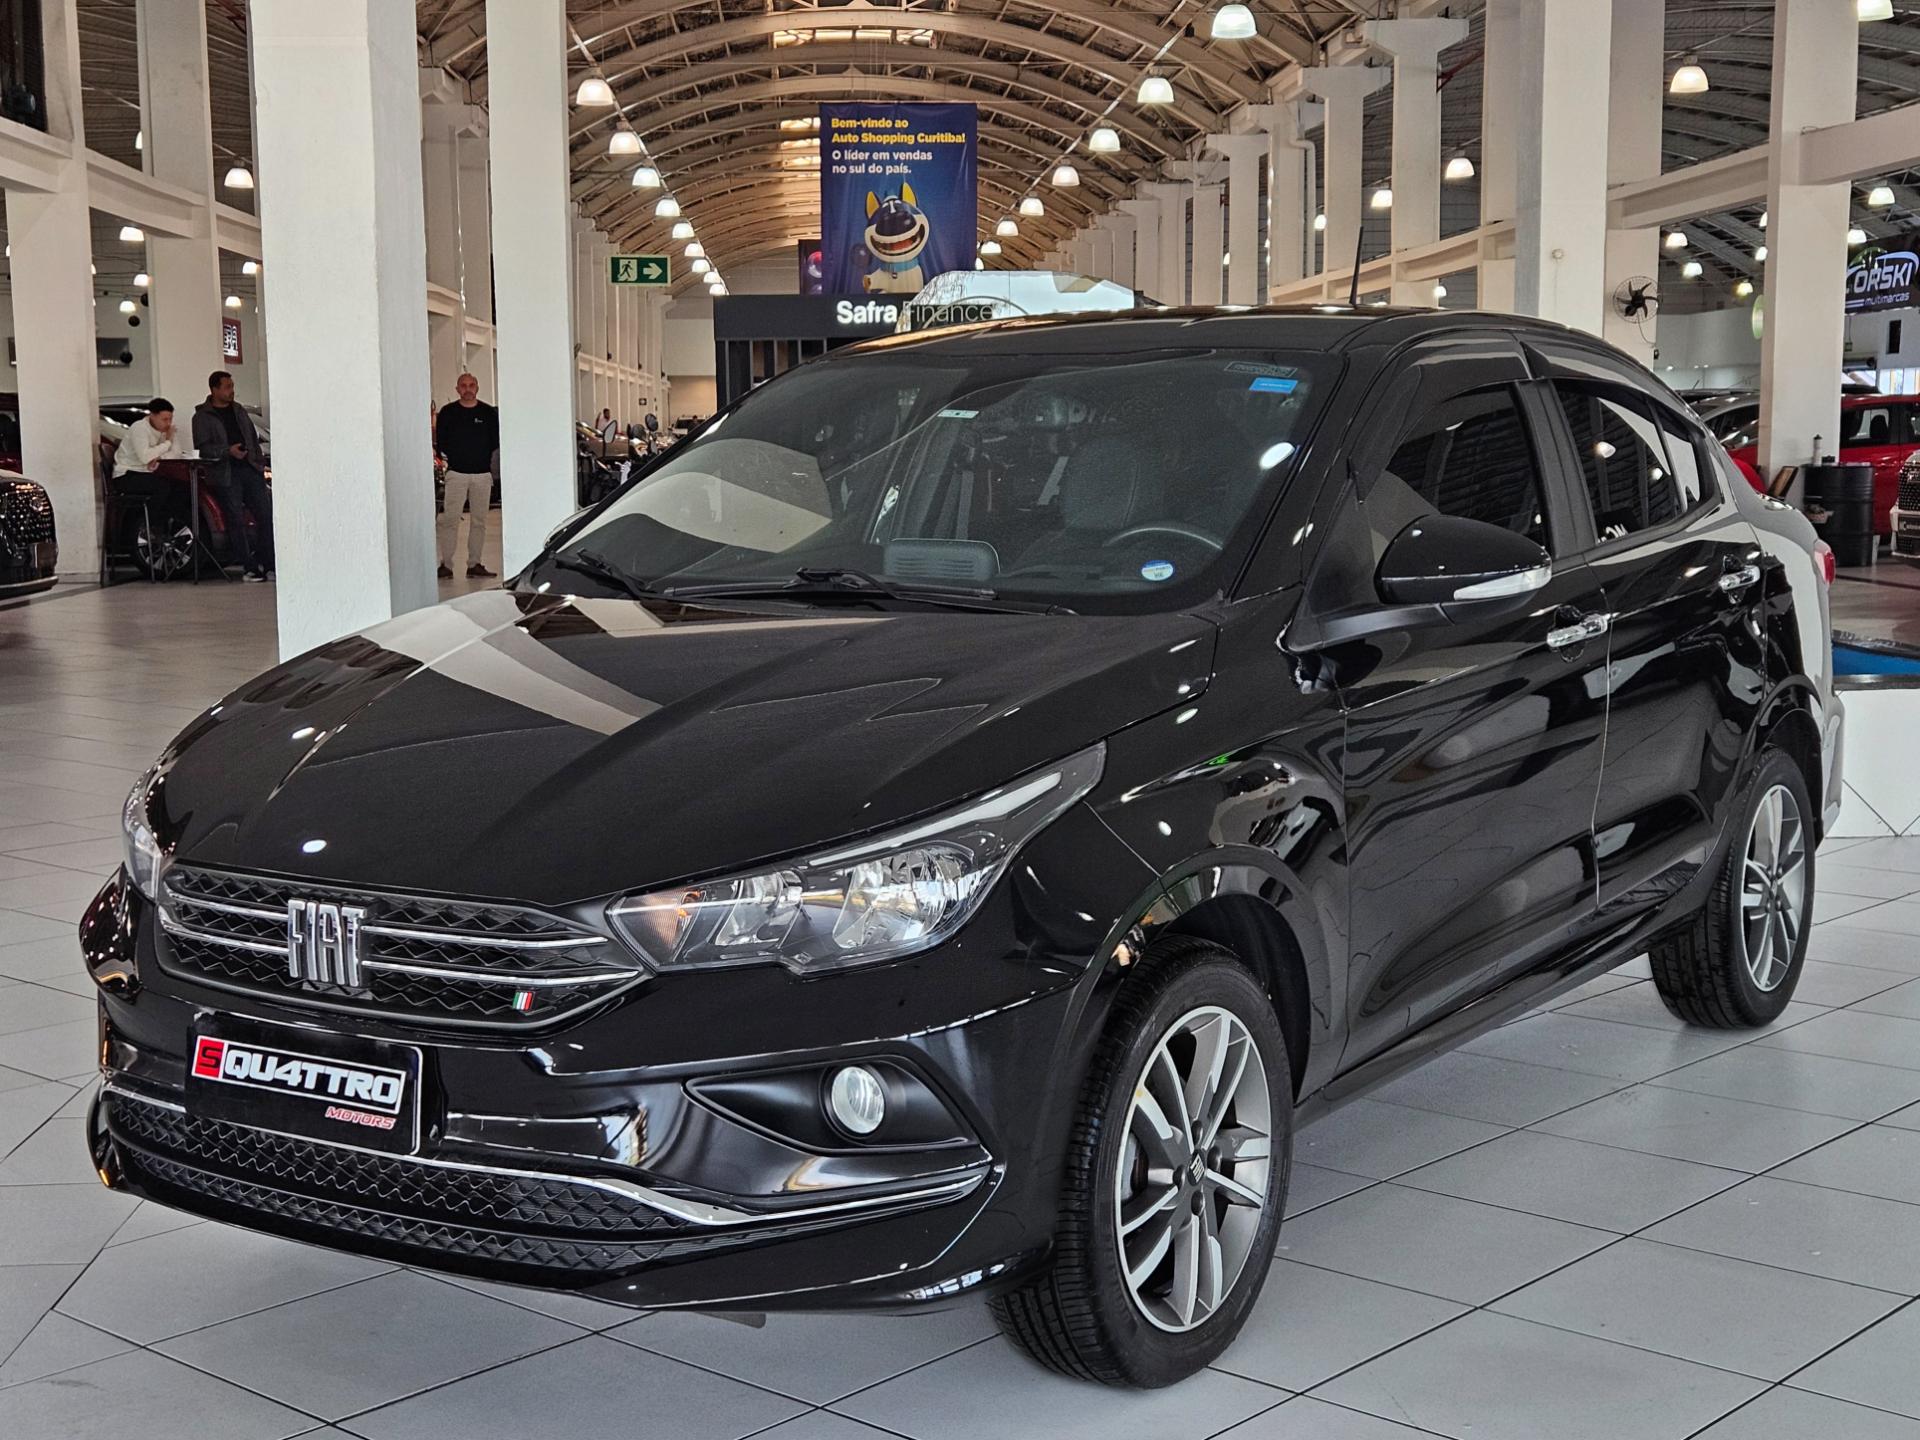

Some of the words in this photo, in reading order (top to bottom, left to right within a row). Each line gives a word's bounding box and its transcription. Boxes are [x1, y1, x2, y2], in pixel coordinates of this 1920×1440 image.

[831, 118, 893, 128] Bem-vindo
[894, 119, 909, 128] ao
[831, 132, 859, 143] Auto
[861, 132, 915, 144] Shopping
[917, 132, 966, 142] Curitiba!
[832, 150, 842, 160] O
[844, 150, 869, 160] líder
[872, 152, 890, 160] em
[893, 150, 933, 160] vendas
[832, 164, 847, 174] no
[849, 163, 865, 174] sul
[868, 163, 883, 174] do
[886, 163, 912, 175] país.
[1865, 292, 1910, 304] multimarcas
[836, 301, 897, 324] Safra
[903, 301, 993, 322] Finance
[288, 900, 368, 987] FIAT
[201, 1046, 401, 1105] SQU4TTRO
[325, 1106, 397, 1130] MOTORS
